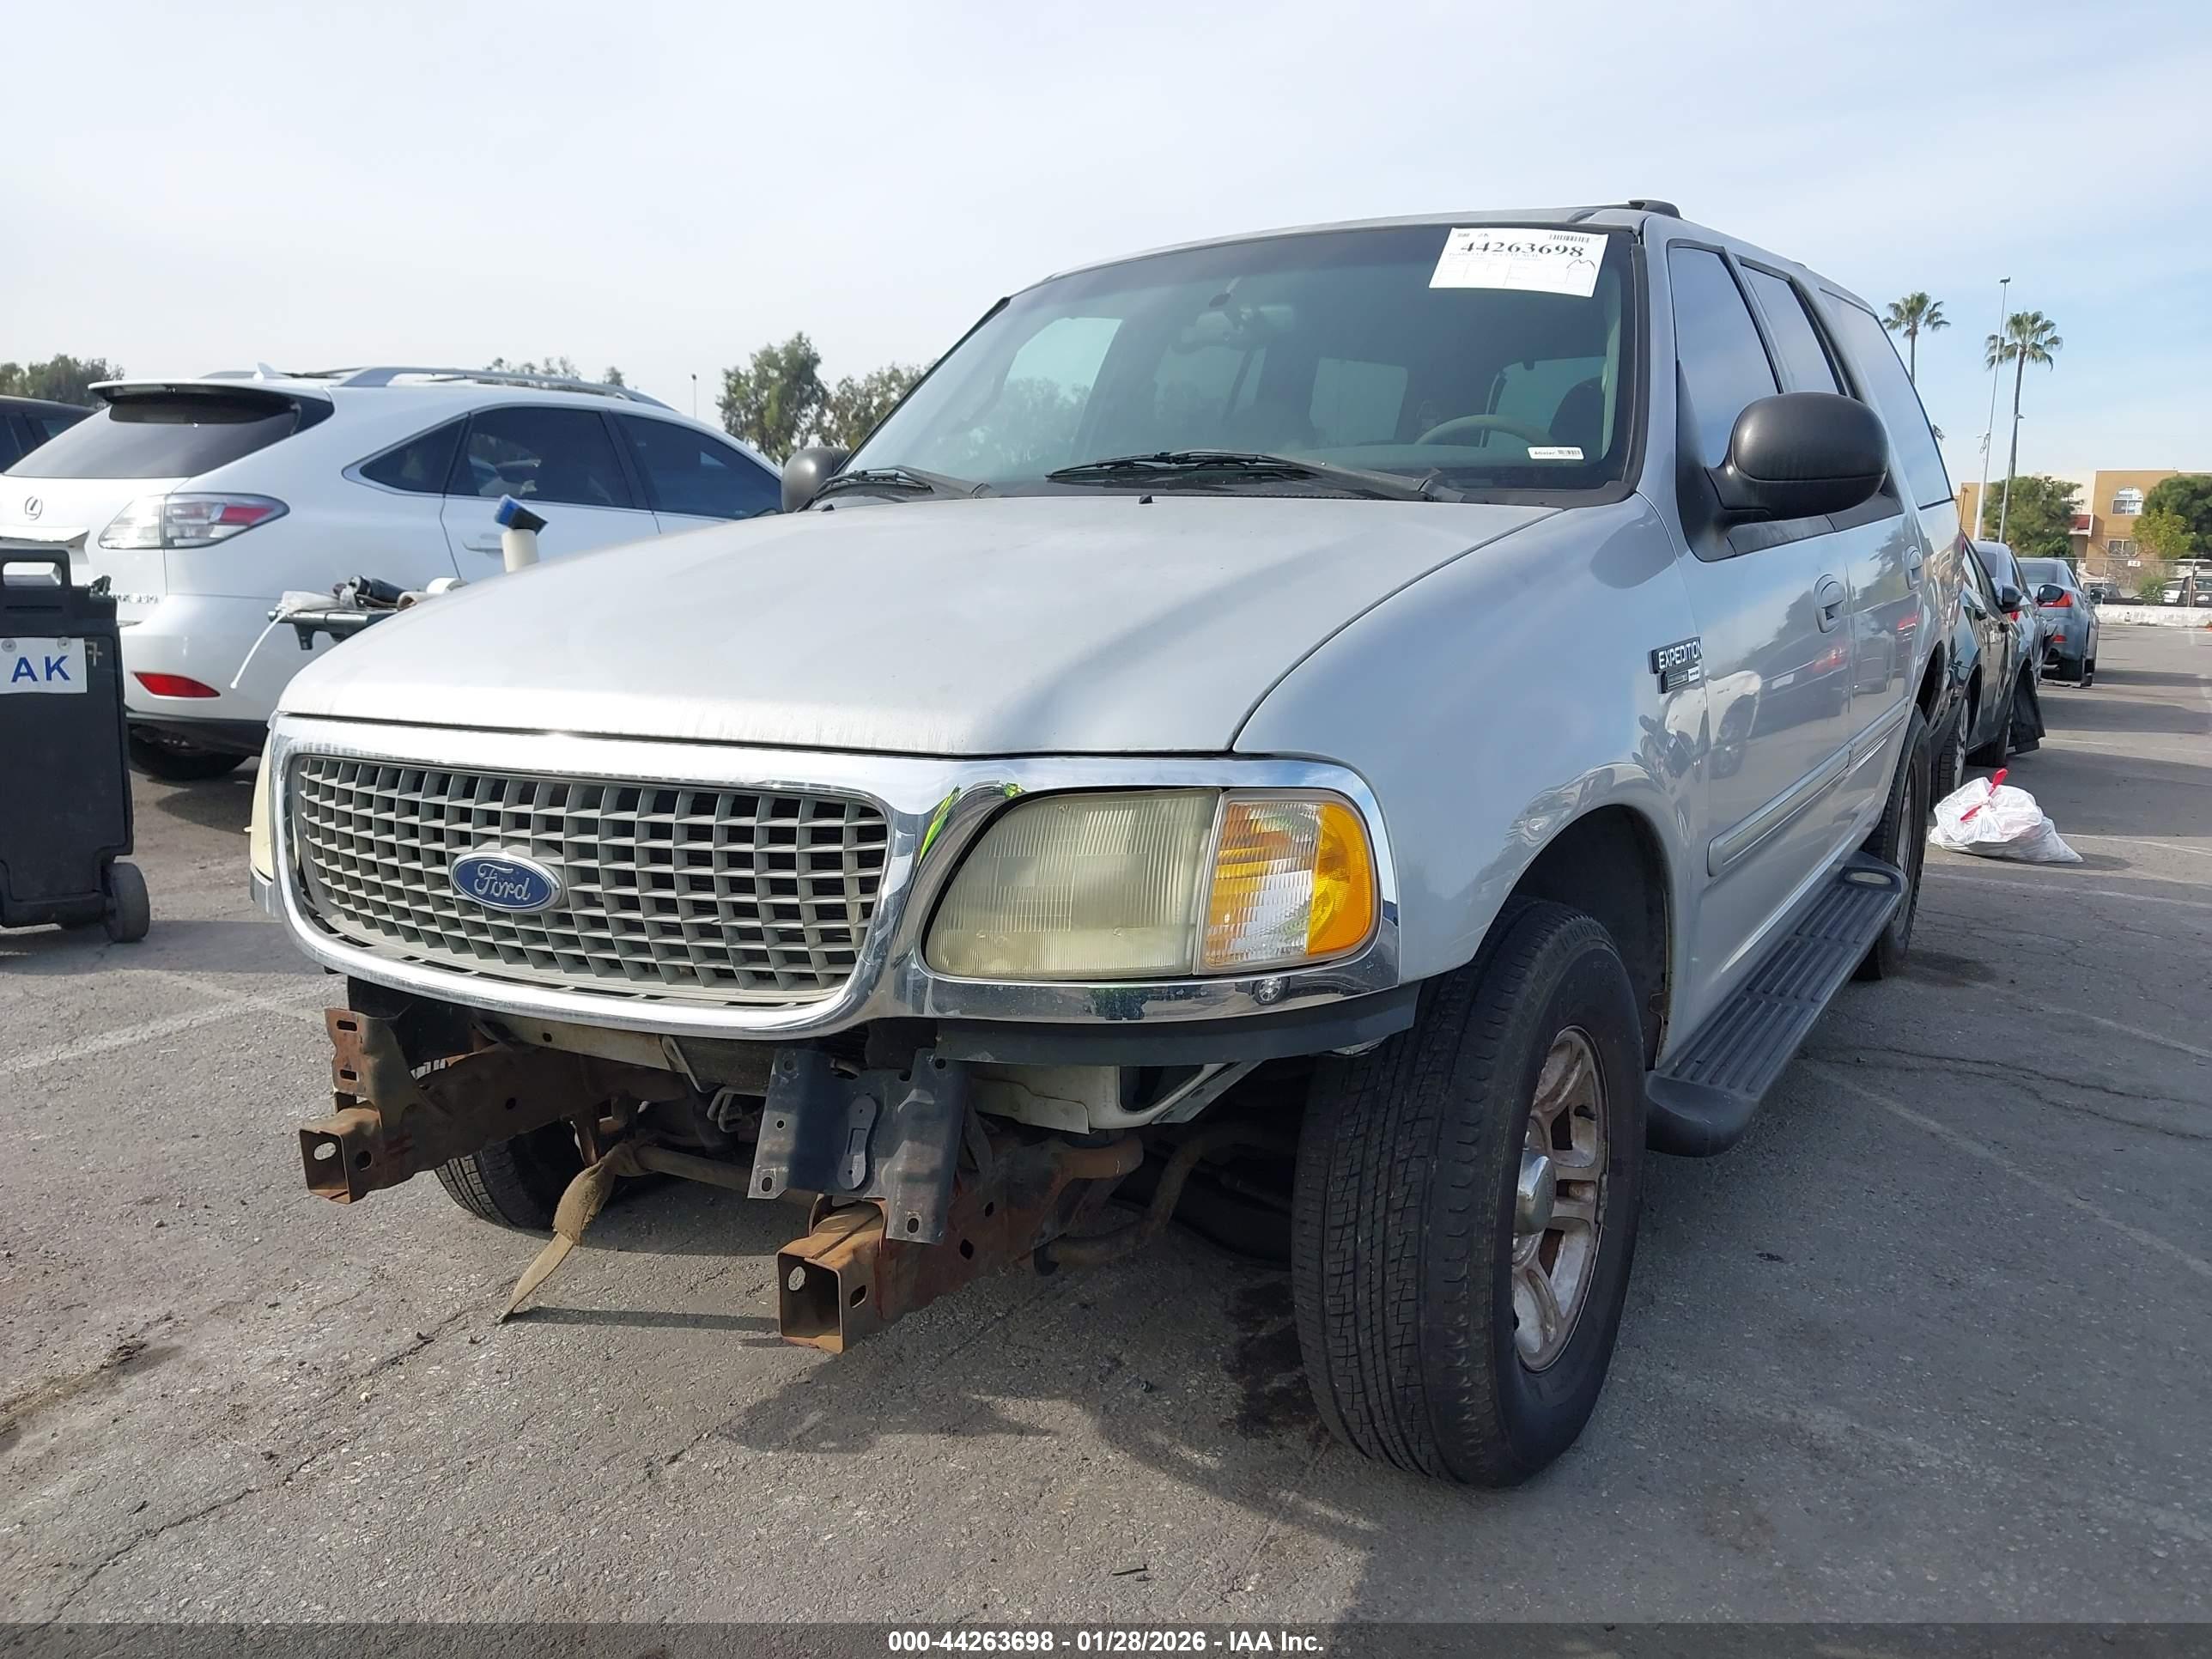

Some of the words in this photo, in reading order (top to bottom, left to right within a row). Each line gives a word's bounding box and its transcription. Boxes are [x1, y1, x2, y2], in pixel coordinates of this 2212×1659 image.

[1460, 241, 1584, 258] 44263698
[11, 655, 71, 682] AK
[1658, 639, 1703, 670] EXPEDITION
[474, 863, 531, 901] Ford
